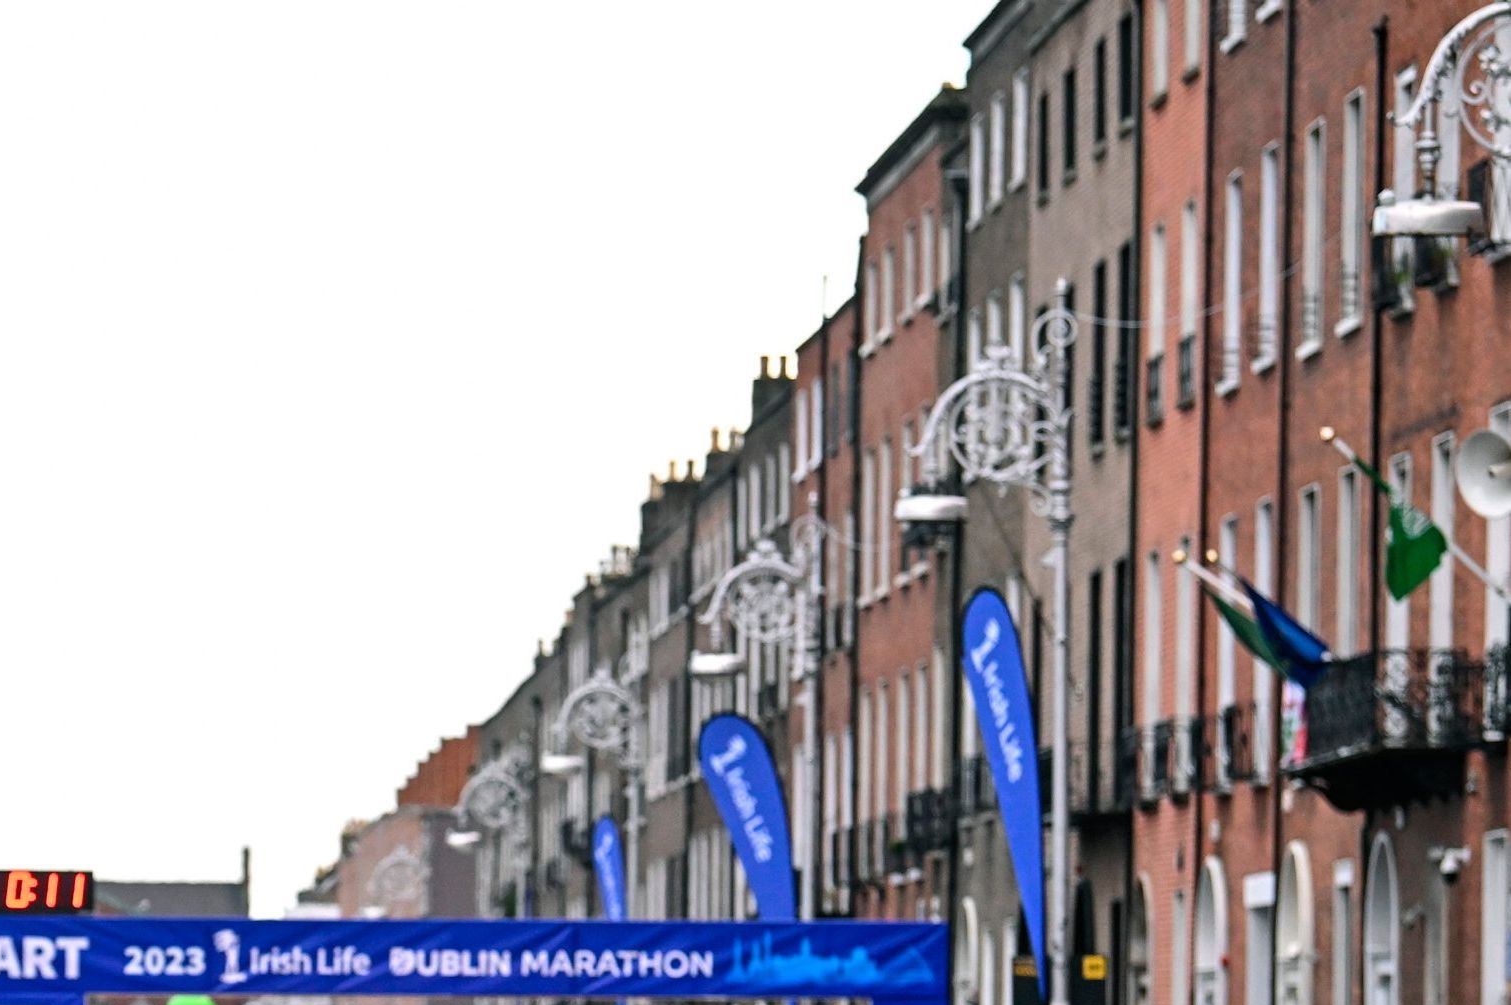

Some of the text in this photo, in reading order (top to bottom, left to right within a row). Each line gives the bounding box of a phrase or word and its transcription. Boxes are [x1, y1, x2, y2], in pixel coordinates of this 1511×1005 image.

[999, 722, 1023, 784] Life
[5, 870, 87, 909] 0:11
[123, 944, 207, 976] 2023
[250, 944, 372, 977] Irish Life
[389, 947, 715, 980] DUBLIN MARATHON
